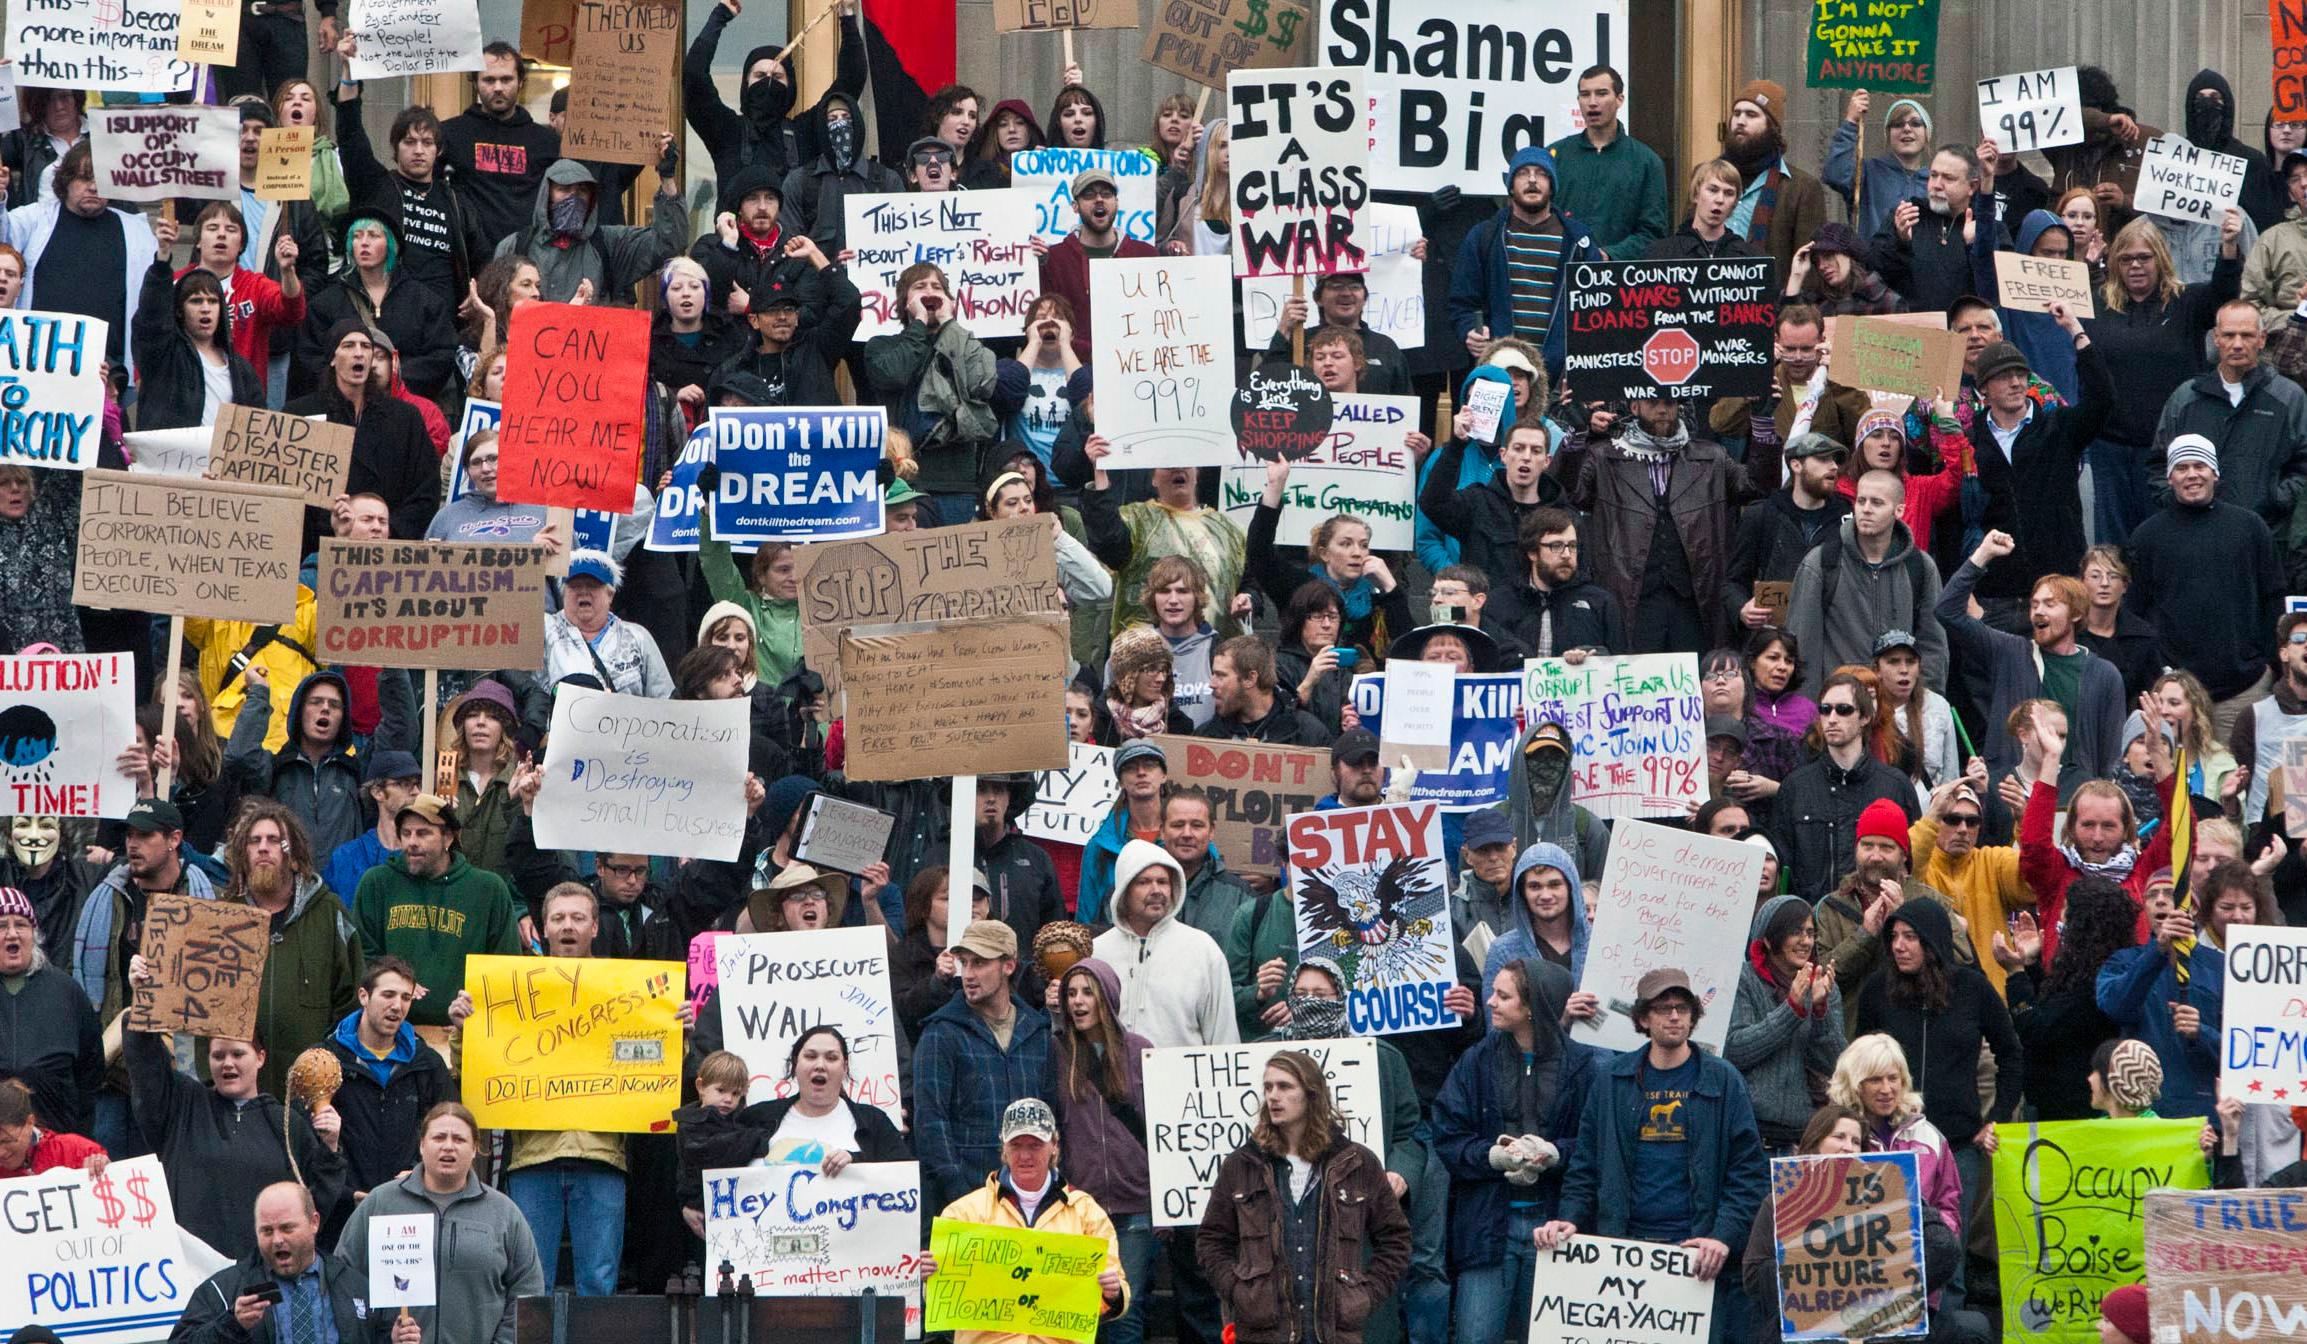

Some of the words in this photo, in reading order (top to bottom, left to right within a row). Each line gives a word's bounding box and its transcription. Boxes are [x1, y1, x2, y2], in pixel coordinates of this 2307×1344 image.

[1871, 2, 1908, 19] NOT
[20, 25, 85, 44] more
[89, 27, 179, 51] important
[190, 40, 224, 51] DREAM
[200, 27, 218, 37] THE
[377, 28, 433, 49] People!
[618, 33, 646, 53] US
[1817, 22, 1892, 40] GONNA
[1833, 39, 1887, 57] TAKE
[1891, 39, 1919, 56] IT
[18, 47, 79, 79] than
[83, 55, 128, 81] this
[382, 60, 420, 72] Dollar
[425, 58, 448, 71] Bill
[1819, 58, 1932, 84] ANYMORE
[1979, 79, 2003, 106] I
[2018, 71, 2056, 99] AM
[1231, 80, 1356, 140] IT'S
[2000, 107, 2068, 151] 99%
[121, 152, 199, 170] OCCUPY
[275, 145, 306, 154] Person
[1013, 149, 1153, 176] CORPORATIONS
[1278, 137, 1309, 165] A
[2148, 137, 2166, 155] I
[2171, 147, 2198, 165] AM
[2209, 152, 2246, 176] THE
[110, 168, 159, 188] WALL
[160, 168, 226, 188] STREET
[1235, 165, 1368, 214] CLASS
[2150, 165, 2234, 198] WORKING
[2161, 190, 2213, 220] POOR
[424, 223, 447, 235] BEEN
[1240, 214, 1365, 270] WAR
[858, 249, 906, 267] ABOUT
[2020, 259, 2071, 281] FREE
[960, 269, 1024, 286] ABOUT
[1575, 265, 1614, 288] OUR
[1623, 265, 1698, 288] COUNTRY
[1707, 264, 1768, 282] CANNOT
[1570, 291, 1612, 311] FUND
[1619, 286, 1682, 309] WARS
[1688, 286, 1765, 303] WITHOUT
[2004, 280, 2089, 305] FREEDOM
[1572, 303, 1649, 332] LOANS
[1654, 311, 1687, 325] FROM
[1690, 310, 1716, 324] THE
[1719, 304, 1776, 327] BANKS
[534, 326, 610, 362] CAN
[1700, 349, 1768, 366] MONGERS
[1116, 350, 1147, 376] WE
[1153, 346, 1184, 370] ARE
[1186, 343, 1215, 364] THE
[1566, 350, 1644, 371] BANKSTERS
[1648, 348, 1695, 366] STOP
[534, 368, 603, 408] YOU
[1134, 377, 1206, 423] 99%
[1240, 389, 1252, 403] is
[1250, 370, 1322, 400] Everything
[1623, 386, 1657, 398] WAR
[1671, 384, 1712, 398] DEBT
[247, 412, 310, 441] END
[503, 412, 578, 448] HEAR
[590, 421, 633, 451] ME
[719, 416, 811, 451] Don't
[821, 415, 880, 450] Kill
[1243, 412, 1297, 429] KEEP
[223, 431, 339, 474] DISASTER
[1240, 430, 1326, 450] SHOPPING
[1327, 432, 1406, 469] PEOPLE
[788, 451, 811, 467] the
[210, 455, 334, 497] CAPITALISM
[720, 469, 877, 506] DREAM
[167, 492, 261, 523] BELIEVE
[735, 514, 861, 528] dontkillthedream.com
[82, 519, 221, 549] CORPORATIONS
[228, 532, 273, 551] ARE
[168, 556, 224, 574] WHEN
[234, 558, 288, 579] TEXAS
[330, 547, 384, 566] THIS
[392, 546, 453, 566] ISN'T
[462, 547, 544, 566] ABOUT
[903, 530, 988, 586] THE
[82, 572, 178, 596] EXECUTES
[196, 581, 248, 602] ONE.
[809, 565, 897, 622] STOP
[343, 598, 388, 618] IT'S
[396, 596, 488, 618] ABOUT
[325, 622, 520, 651] CORRUPTION
[1527, 668, 1598, 702] CORRUPT
[1670, 662, 1696, 695] US
[1543, 662, 1563, 675] THE
[568, 695, 740, 749] Corporatism
[1600, 692, 1675, 730] SUPPORT
[1680, 695, 1703, 722] US
[1661, 726, 1693, 753] US
[584, 757, 695, 802] Destroying
[1604, 763, 1636, 785] THE
[11, 783, 100, 816] TIME!
[1289, 804, 1437, 870] STAY
[748, 953, 885, 985] PROSECUTE
[482, 963, 582, 1038] HEY
[1347, 981, 1456, 1034] COURSE
[1184, 1052, 1250, 1089] THE
[485, 1076, 517, 1101] DO
[524, 1076, 536, 1097] I
[548, 1077, 616, 1097] MATTER
[1007, 1107, 1048, 1123] USAF
[1181, 1090, 1234, 1120] ALL
[707, 1176, 776, 1226] Hey
[786, 1168, 919, 1231] Congress
[1844, 1172, 1886, 1207] IS
[4, 1184, 81, 1234] GET
[2184, 1194, 2307, 1232] TRUE
[55, 1236, 100, 1261] OUT
[102, 1233, 132, 1256] OF
[1804, 1213, 1899, 1259] OUR
[2036, 1215, 2142, 1275] Boise
[939, 1232, 1024, 1277] LAND
[1011, 1265, 1033, 1282] OF
[1611, 1244, 1644, 1267] TO
[28, 1258, 177, 1314] POLITICS
[783, 1264, 851, 1285] matter
[1597, 1276, 1647, 1300] MY
[1779, 1259, 1889, 1290] FUTURE
[929, 1279, 1014, 1324] HOME
[1018, 1294, 1040, 1307] OF
[1534, 1294, 1706, 1336] MEGA-YACHT
